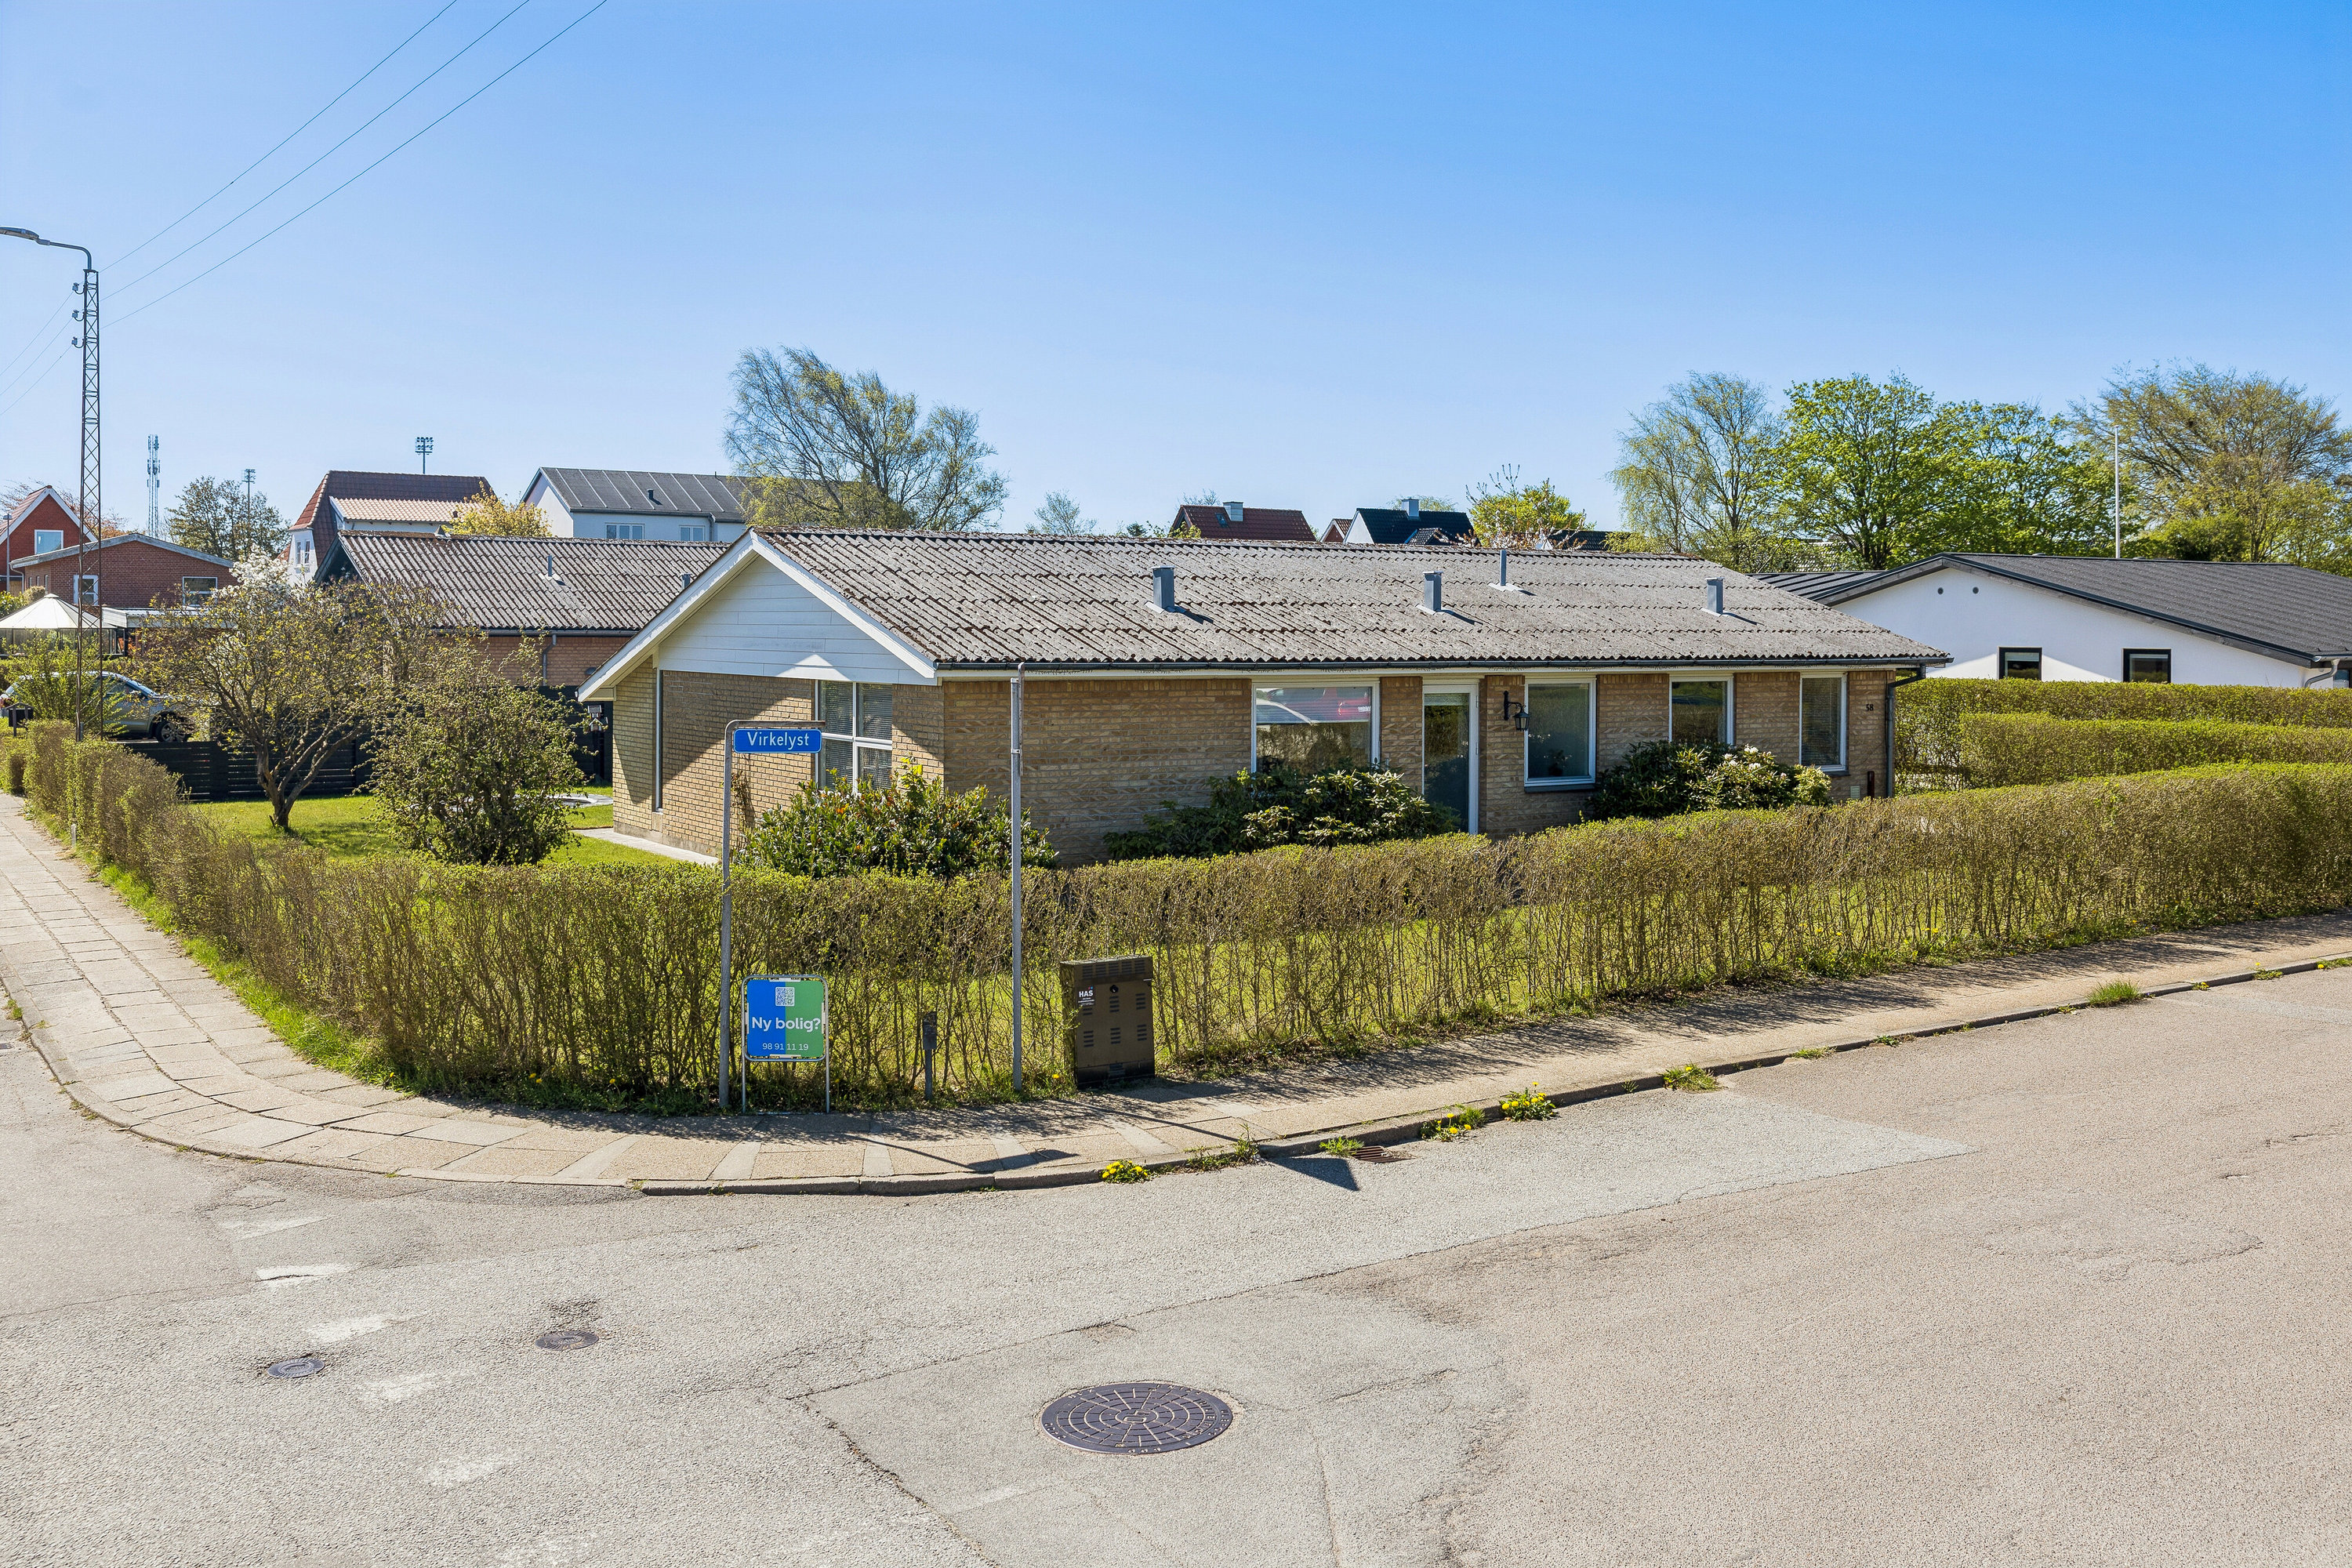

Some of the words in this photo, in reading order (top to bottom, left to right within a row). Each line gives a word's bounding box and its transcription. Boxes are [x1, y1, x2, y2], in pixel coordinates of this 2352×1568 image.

[747, 731, 809, 750] Virkelyst
[752, 1016, 772, 1032] Ny
[775, 1017, 821, 1033] bolig?
